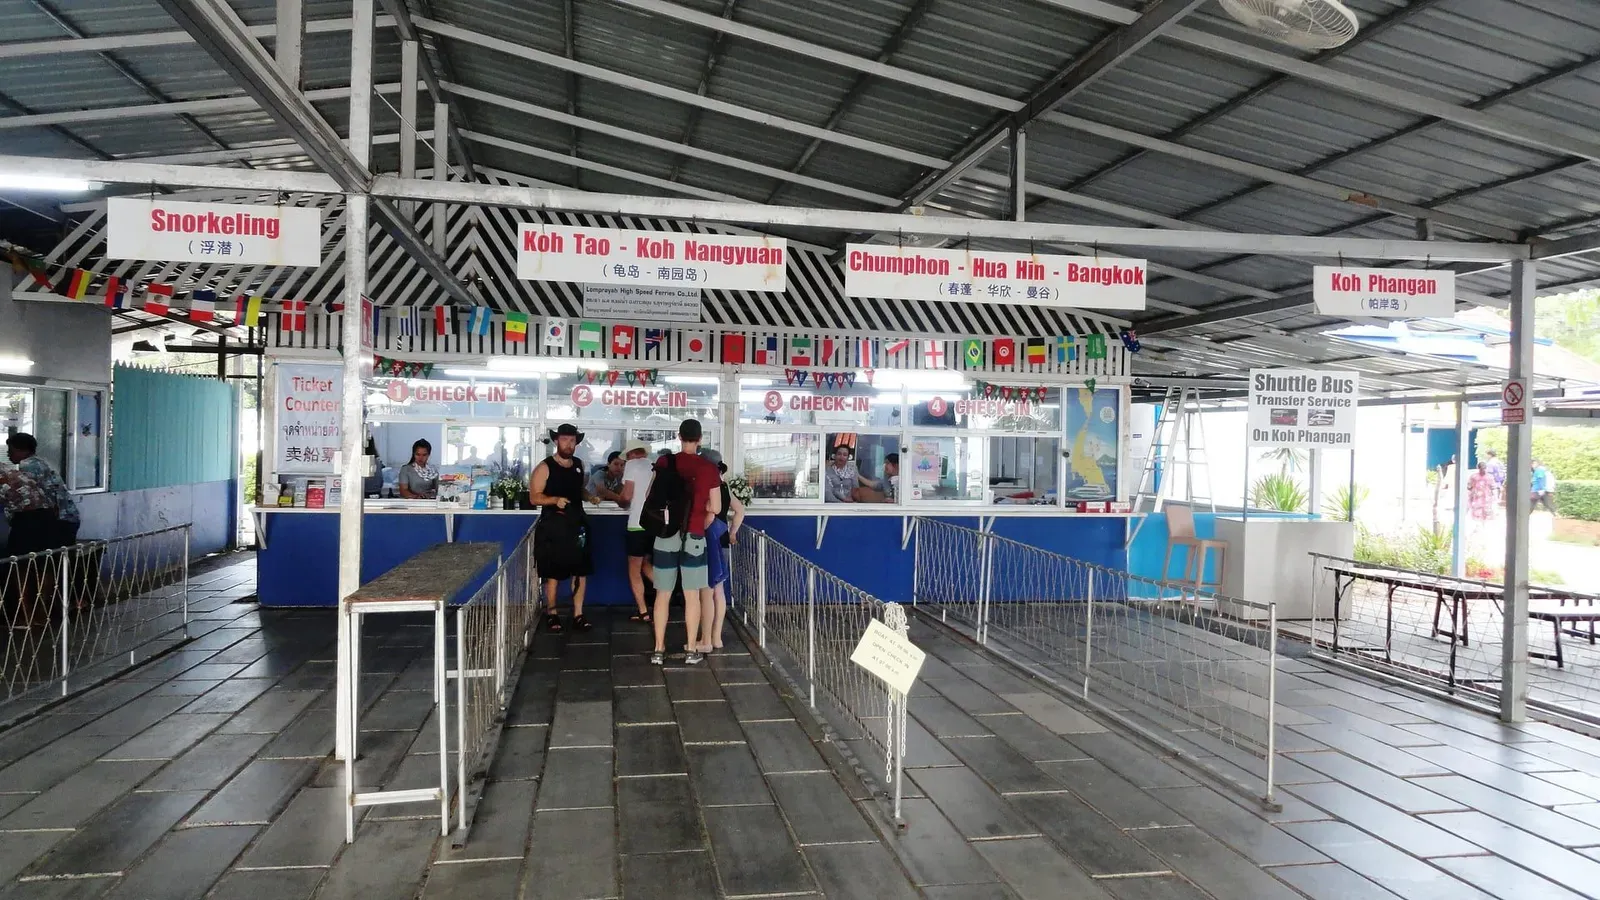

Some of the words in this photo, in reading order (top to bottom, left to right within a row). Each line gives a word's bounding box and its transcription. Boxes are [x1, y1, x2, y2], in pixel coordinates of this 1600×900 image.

[151, 208, 280, 239] Snorkeling
[523, 230, 563, 253] Koh
[573, 233, 610, 256] Tao
[636, 237, 675, 260] Koh
[684, 240, 782, 265] Nangyuan
[850, 250, 949, 276] Chumphon
[973, 257, 1007, 279] Hua
[1016, 260, 1045, 280] Hin
[1067, 263, 1144, 286] Bangkok
[586, 286, 618, 294] Lomprayah
[636, 288, 652, 296] Speed
[987, 284, 1011, 298] 华欣
[1331, 273, 1361, 291] Koh
[1368, 274, 1436, 295] Phangan
[292, 377, 333, 392] Ticket
[1255, 373, 1317, 393] Shuttle
[1321, 376, 1353, 393] Bus
[415, 386, 506, 402] CHECK-IN
[601, 390, 687, 407] CHECK-IN
[1256, 394, 1305, 407] Transfer
[1307, 396, 1351, 407] Service
[285, 397, 340, 411] Counter
[789, 395, 869, 411] CHECK-IN
[1253, 429, 1268, 441] On
[1272, 429, 1295, 442] Koh
[1298, 430, 1351, 444] Phangan
[872, 641, 886, 653] OPEN
[887, 650, 903, 665] CHECK
